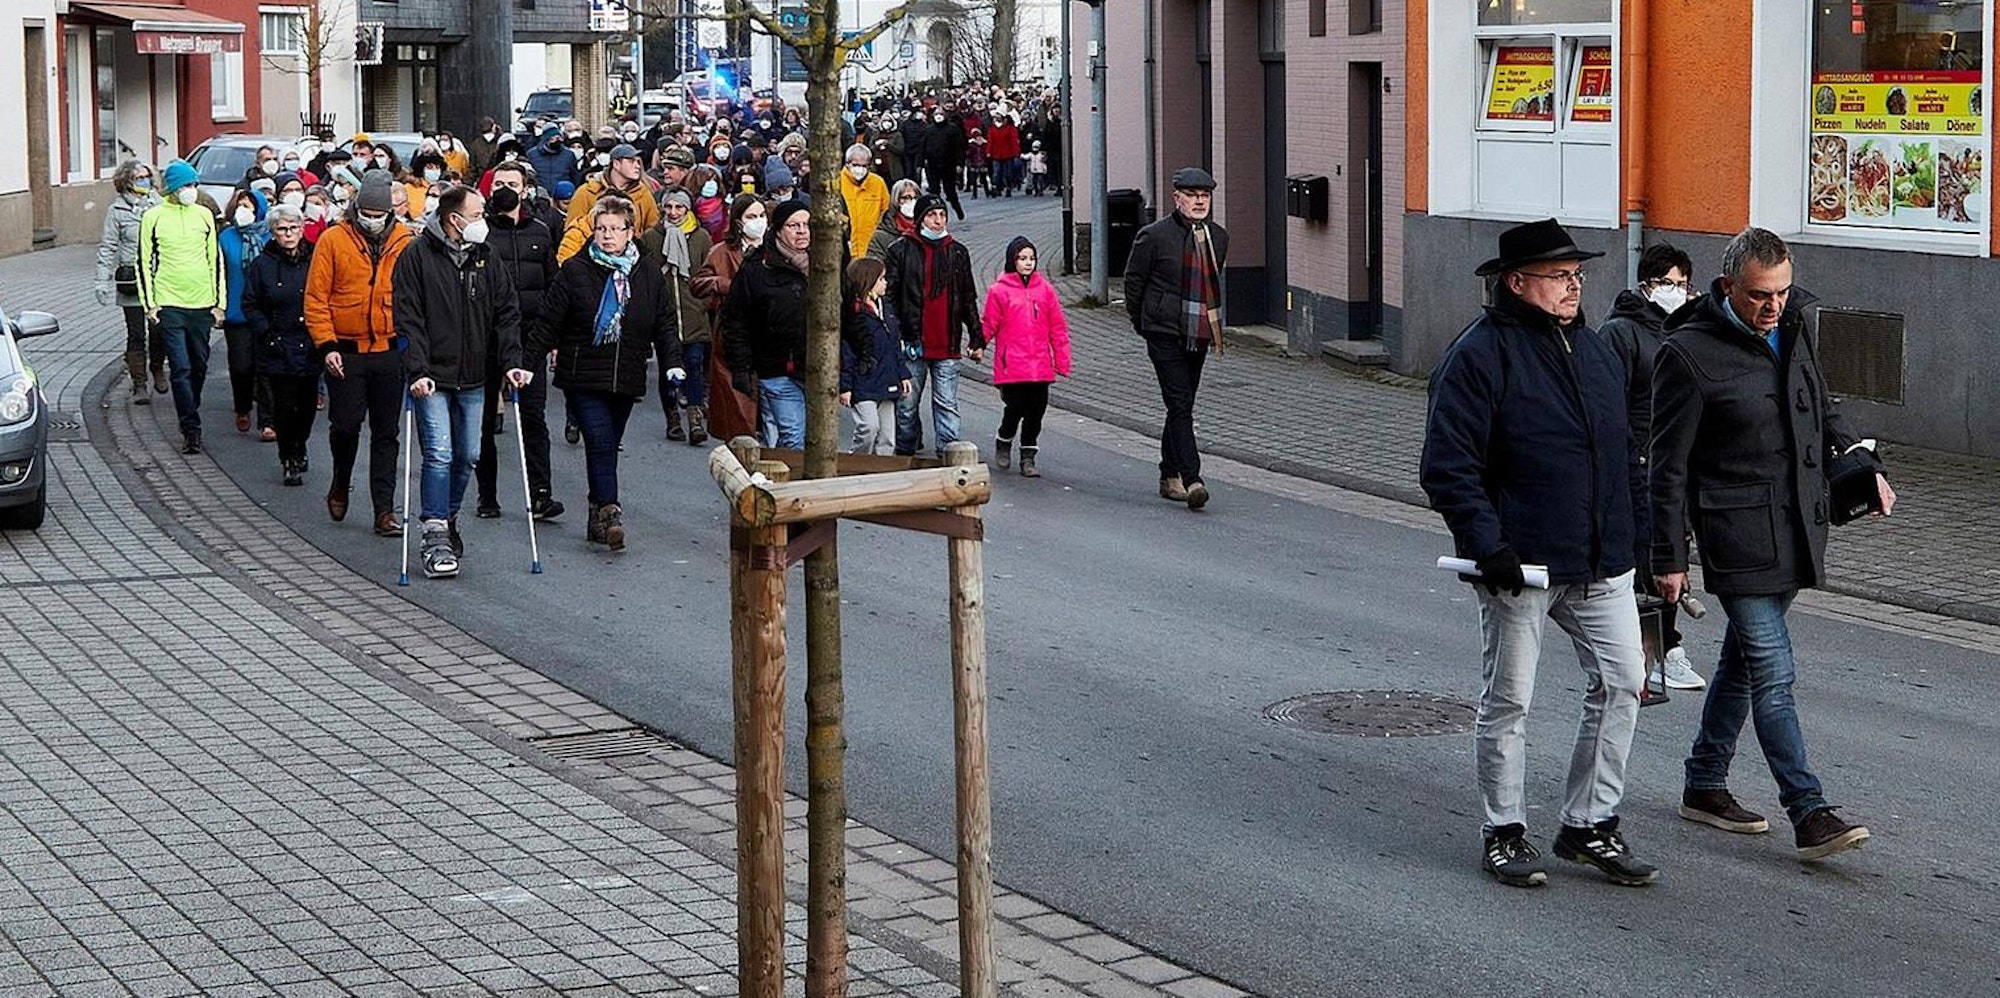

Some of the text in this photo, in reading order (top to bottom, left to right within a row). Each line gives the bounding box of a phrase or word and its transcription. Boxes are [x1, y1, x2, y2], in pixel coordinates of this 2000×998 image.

[1818, 73, 1875, 83] MITTAGSANGEBOT
[1814, 118, 1977, 131] Pizzen Nudeln Salate Döner
